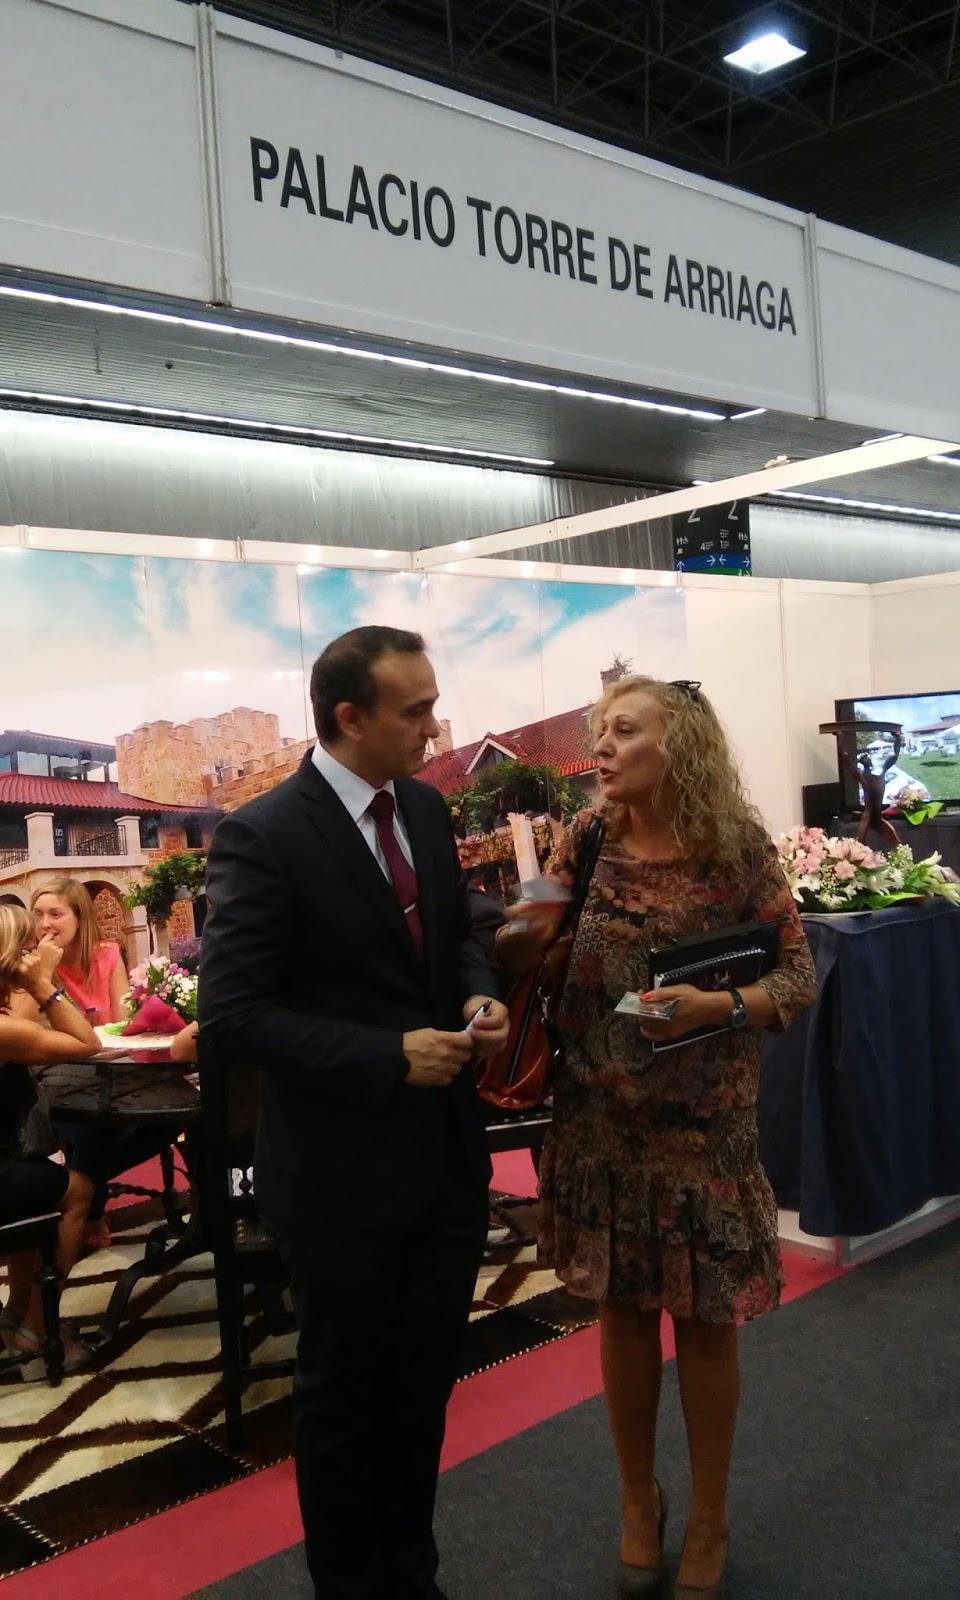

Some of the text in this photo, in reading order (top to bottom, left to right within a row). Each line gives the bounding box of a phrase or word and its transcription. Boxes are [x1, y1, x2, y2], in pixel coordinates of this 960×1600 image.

[251, 137, 796, 335] PALACIO TORRE DE ARRIAGA
